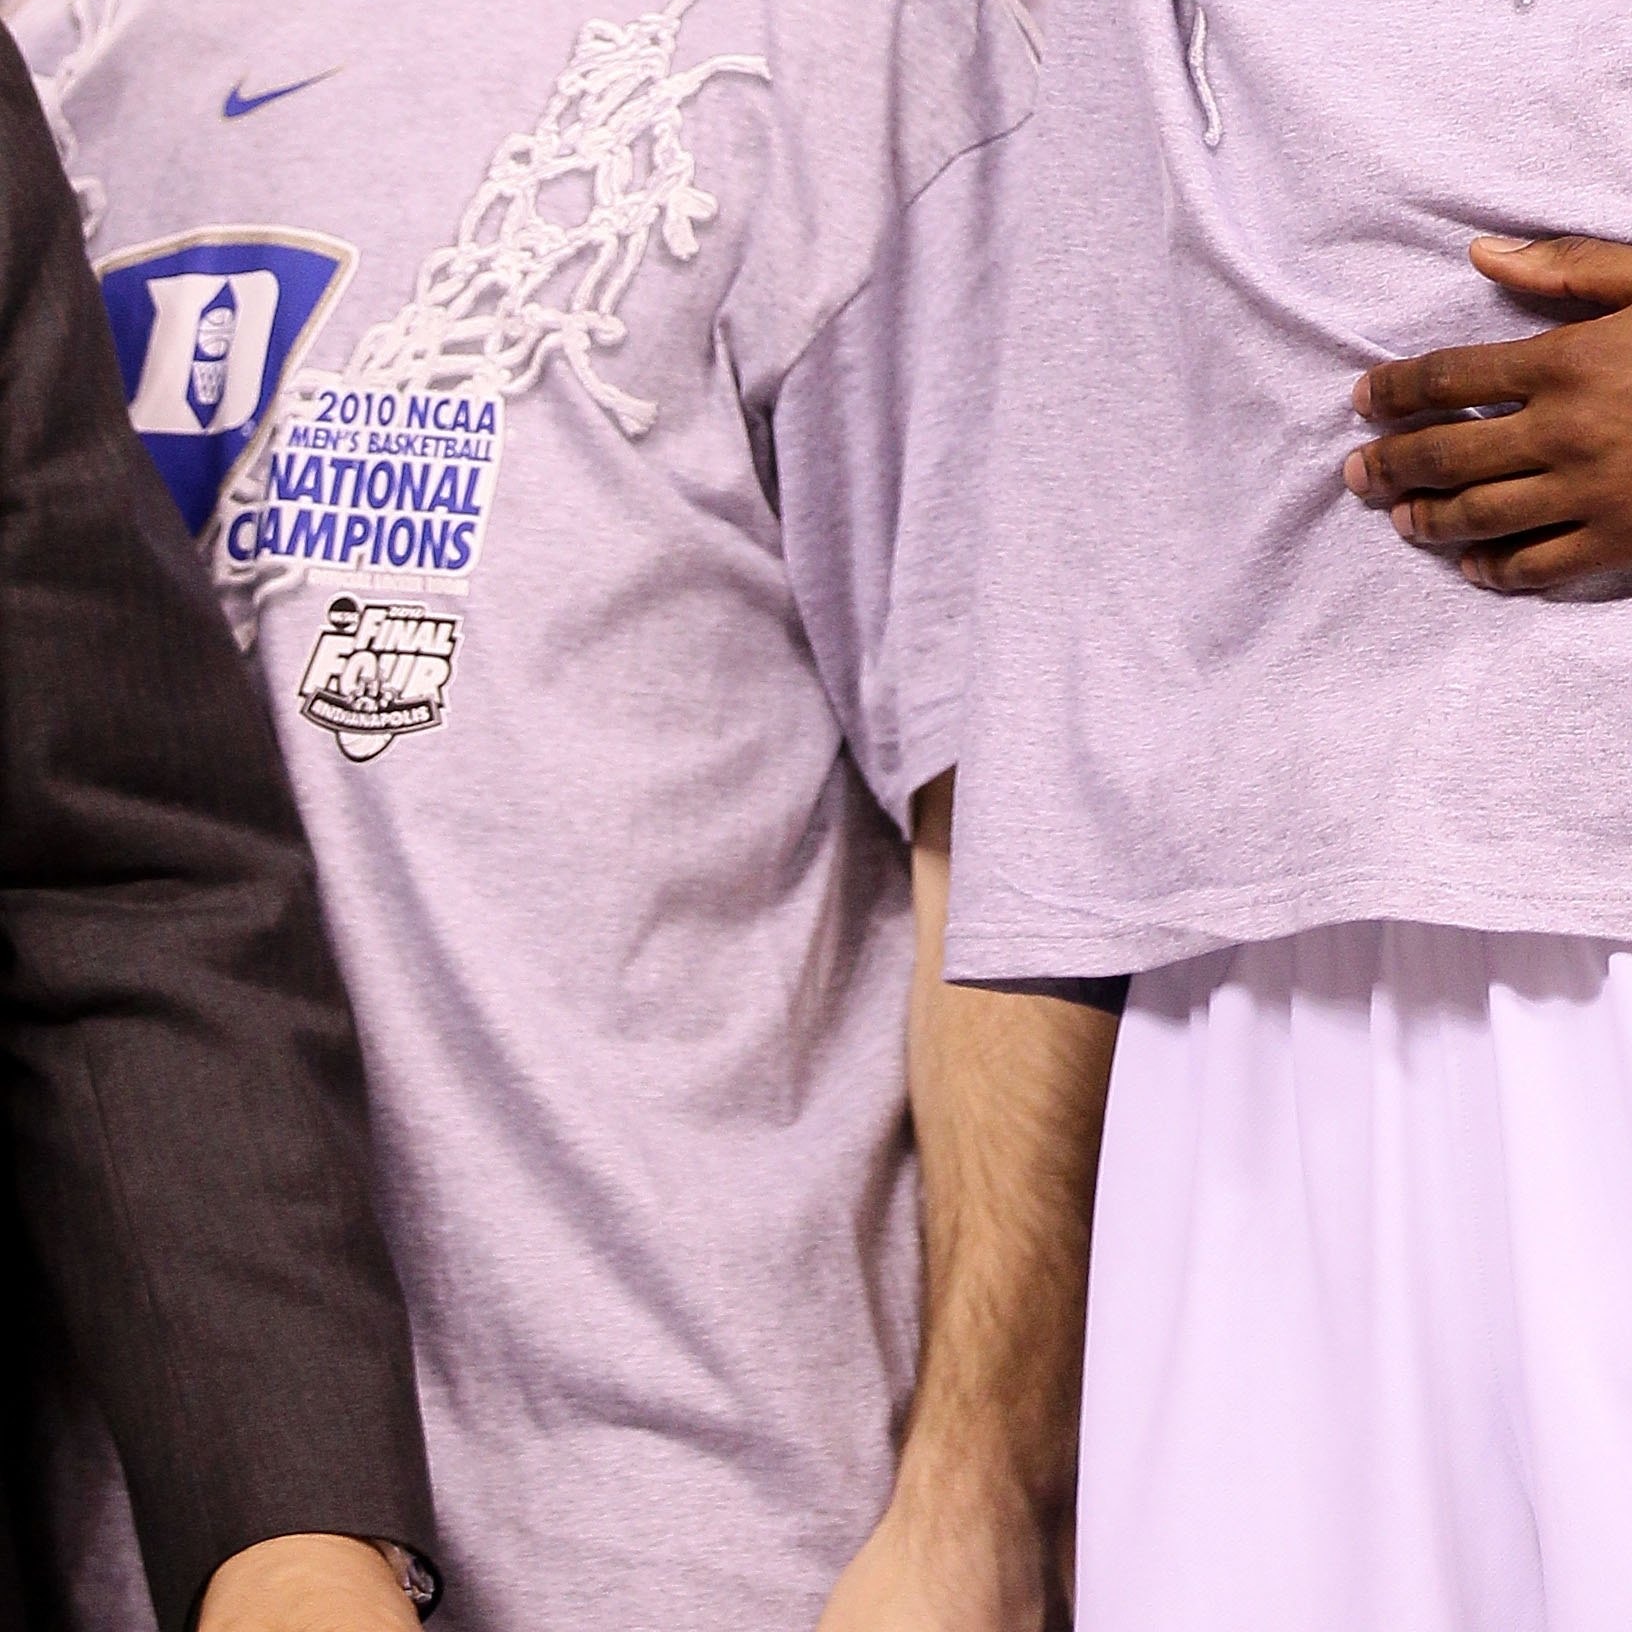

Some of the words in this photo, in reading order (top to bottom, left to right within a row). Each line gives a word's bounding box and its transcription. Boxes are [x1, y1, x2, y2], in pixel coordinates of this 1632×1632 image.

[316, 391, 396, 426] 2010
[406, 395, 496, 434] NCAA
[288, 424, 358, 453] MEN'S
[368, 431, 493, 462] BASKETBALL
[268, 453, 481, 516] NATIONAL
[356, 607, 456, 655] FINAL
[302, 633, 450, 704] FOUR
